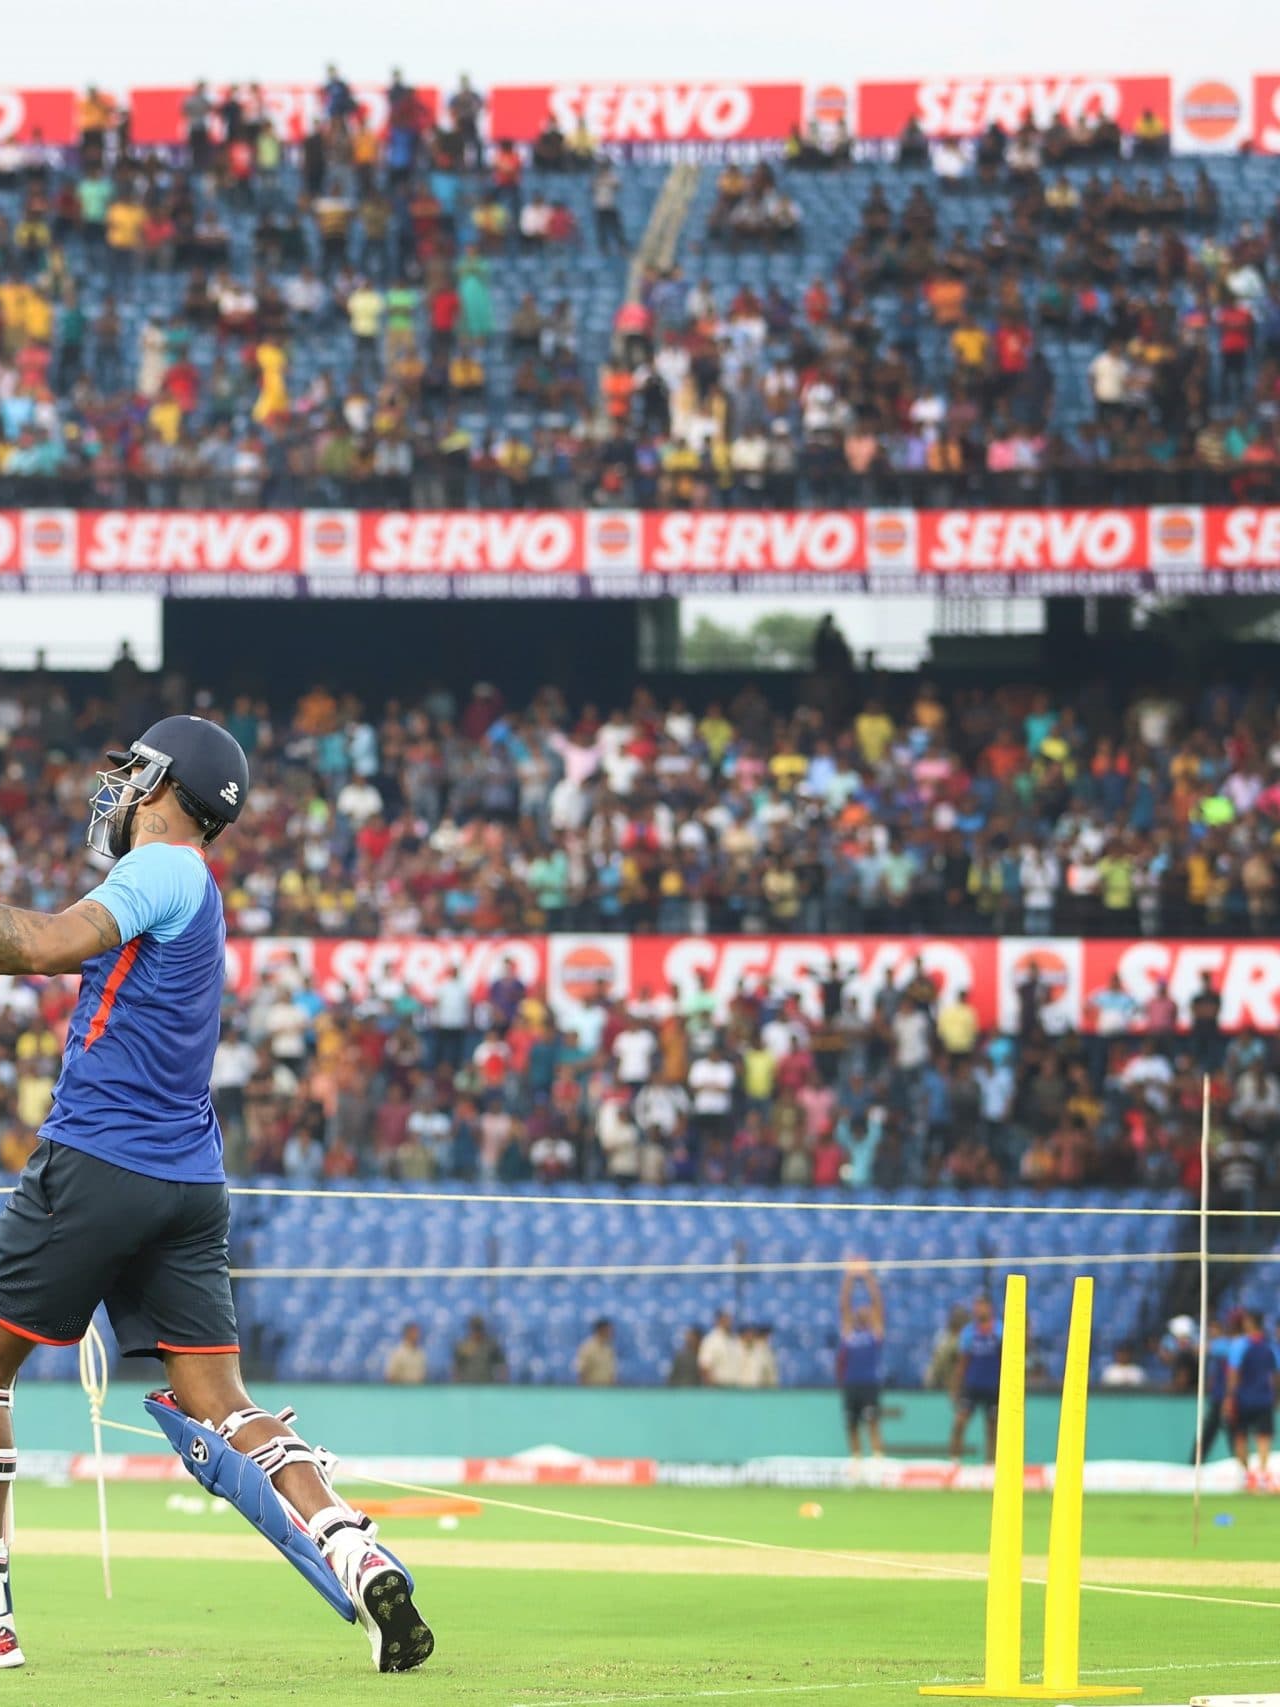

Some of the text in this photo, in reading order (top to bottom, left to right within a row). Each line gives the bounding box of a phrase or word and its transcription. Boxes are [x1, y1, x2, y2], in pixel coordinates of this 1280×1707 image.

[542, 86, 752, 138] SERVO
[915, 81, 1122, 134] SERVO
[86, 512, 293, 571] SERVO
[368, 512, 576, 571] SERVO
[651, 511, 858, 569] SERVO
[929, 510, 1136, 568] SERVO
